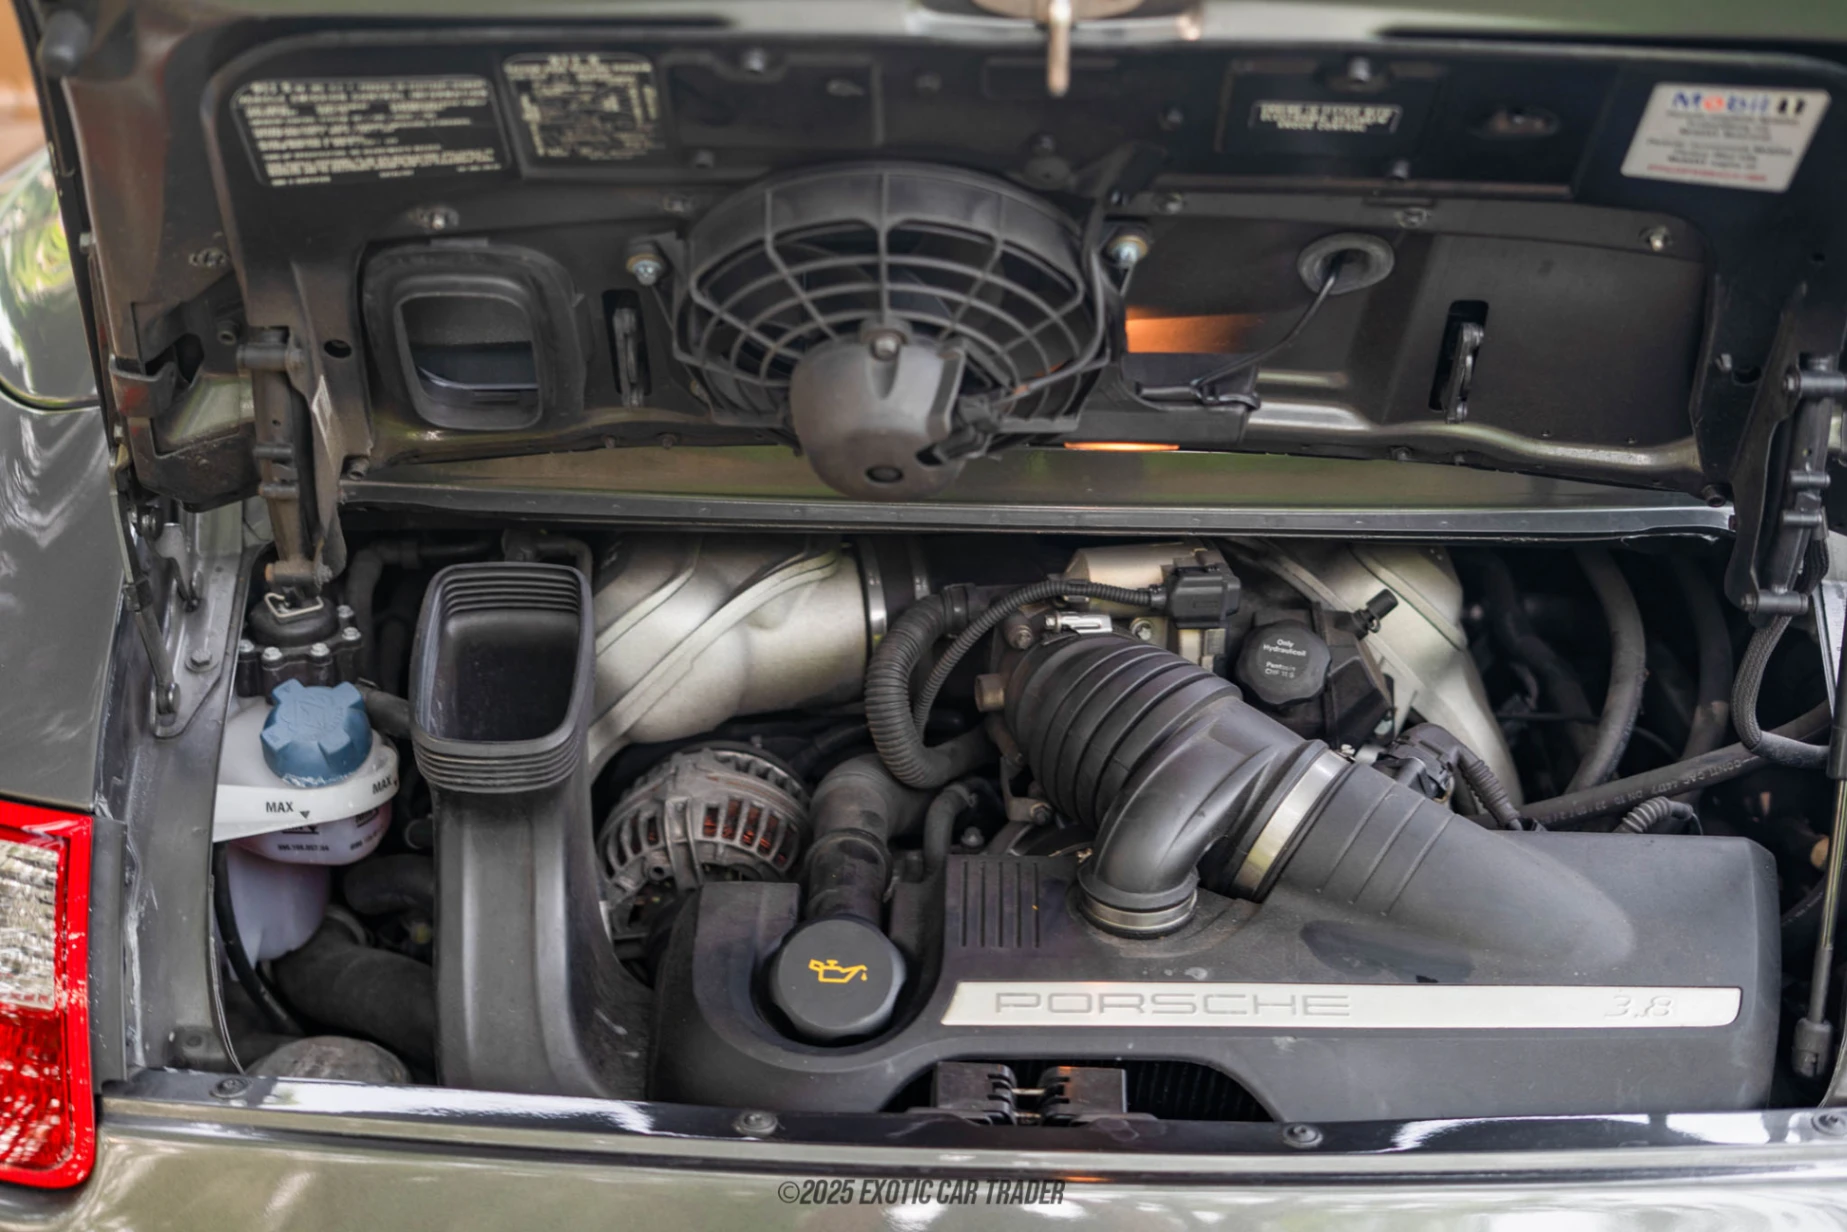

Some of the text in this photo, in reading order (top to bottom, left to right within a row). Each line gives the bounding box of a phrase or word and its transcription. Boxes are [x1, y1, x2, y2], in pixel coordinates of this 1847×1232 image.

[1673, 91, 1768, 113] Mobil
[1276, 638, 1295, 648] Only
[372, 775, 393, 795] MAX
[265, 801, 294, 813] MAX
[995, 992, 1672, 1018] PORSCHE 3.8
